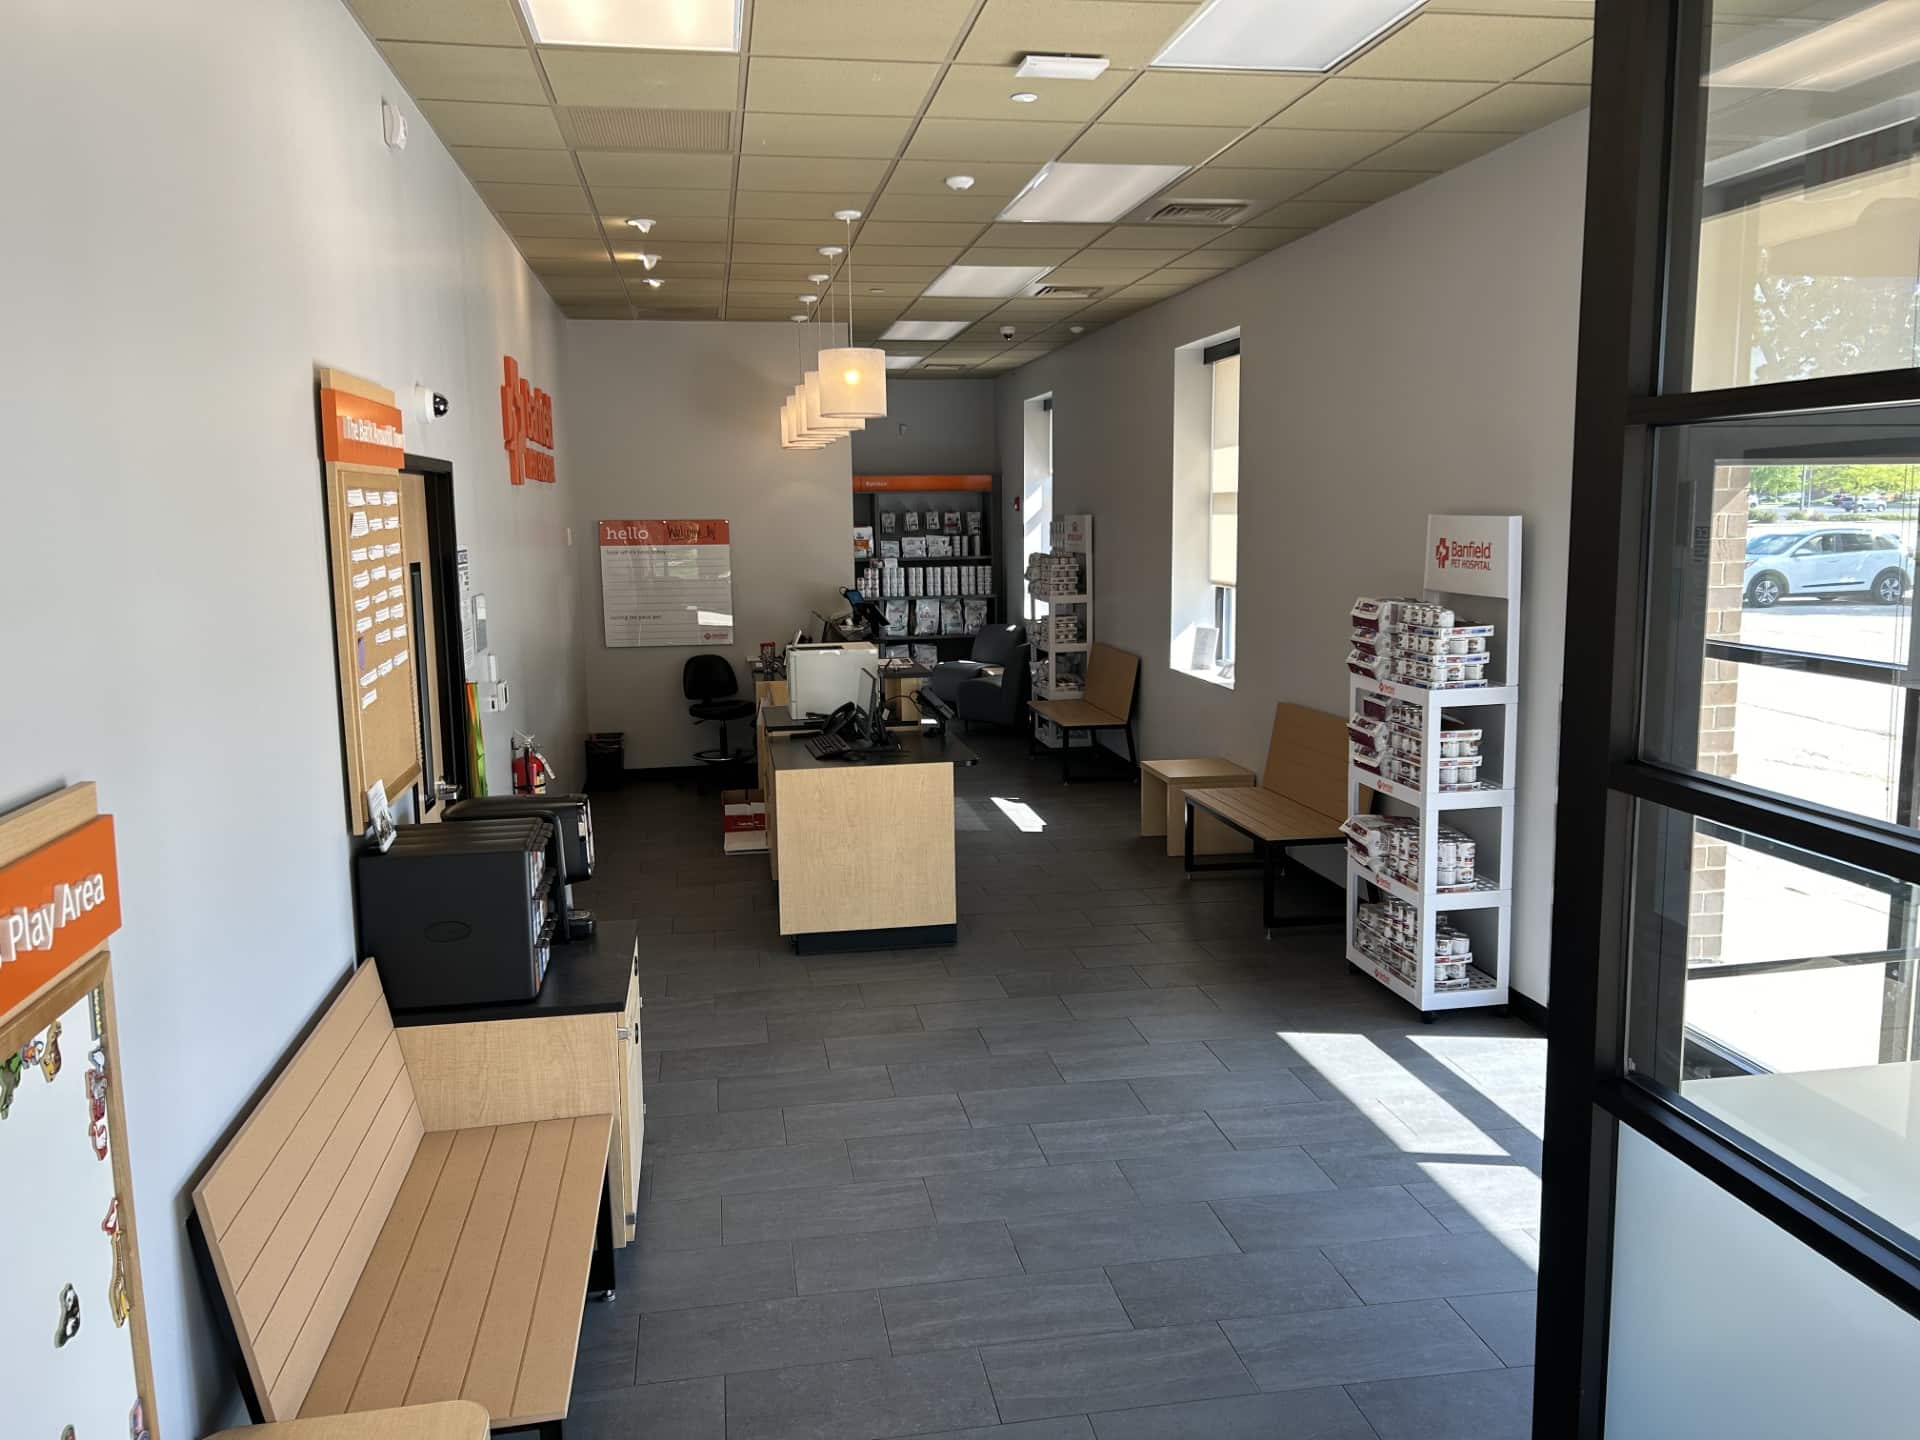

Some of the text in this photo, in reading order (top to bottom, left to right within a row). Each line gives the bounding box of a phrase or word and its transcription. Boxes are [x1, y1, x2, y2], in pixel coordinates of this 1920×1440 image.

[606, 527, 649, 540] hello
[1451, 541, 1491, 559] Banfield
[1451, 559, 1491, 571] PET HOSPITAL
[8, 873, 105, 961] Play Area
